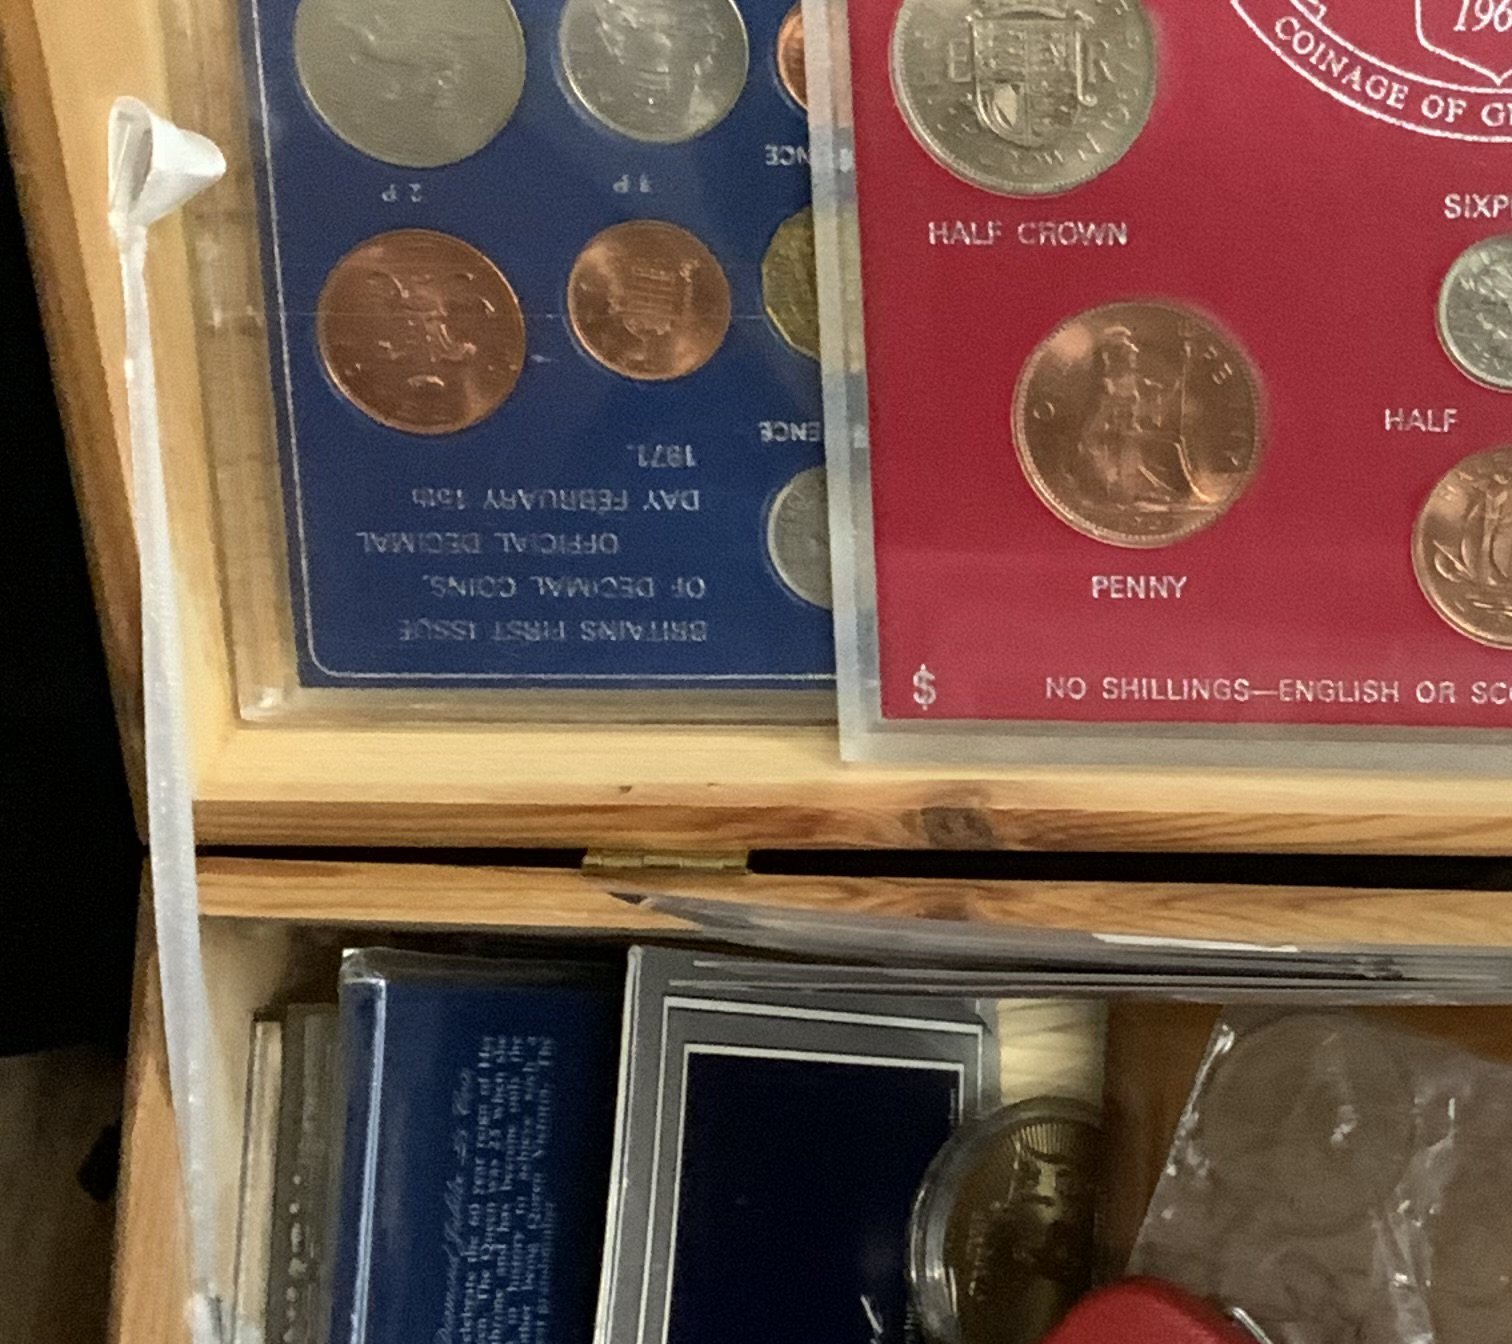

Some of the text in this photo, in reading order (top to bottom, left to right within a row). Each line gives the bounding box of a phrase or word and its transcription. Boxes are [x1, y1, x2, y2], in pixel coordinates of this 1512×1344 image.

[1275, 15, 1408, 111] COINAGE
[1421, 94, 1467, 124] OF
[928, 221, 1128, 246] HALF CROWN
[1384, 408, 1457, 433] HALF
[483, 488, 628, 511] FEBRUARY
[644, 488, 699, 511] DAY
[356, 530, 619, 554] OFFICIAL DECIMAL
[530, 575, 655, 598] DECIMAL
[672, 576, 706, 599] OF
[1091, 575, 1187, 599] PENNY
[399, 618, 707, 644] BRITAINS FIRST ISSUE
[912, 664, 937, 711] $
[1045, 676, 1087, 700] NO
[1415, 680, 1456, 704] OR
